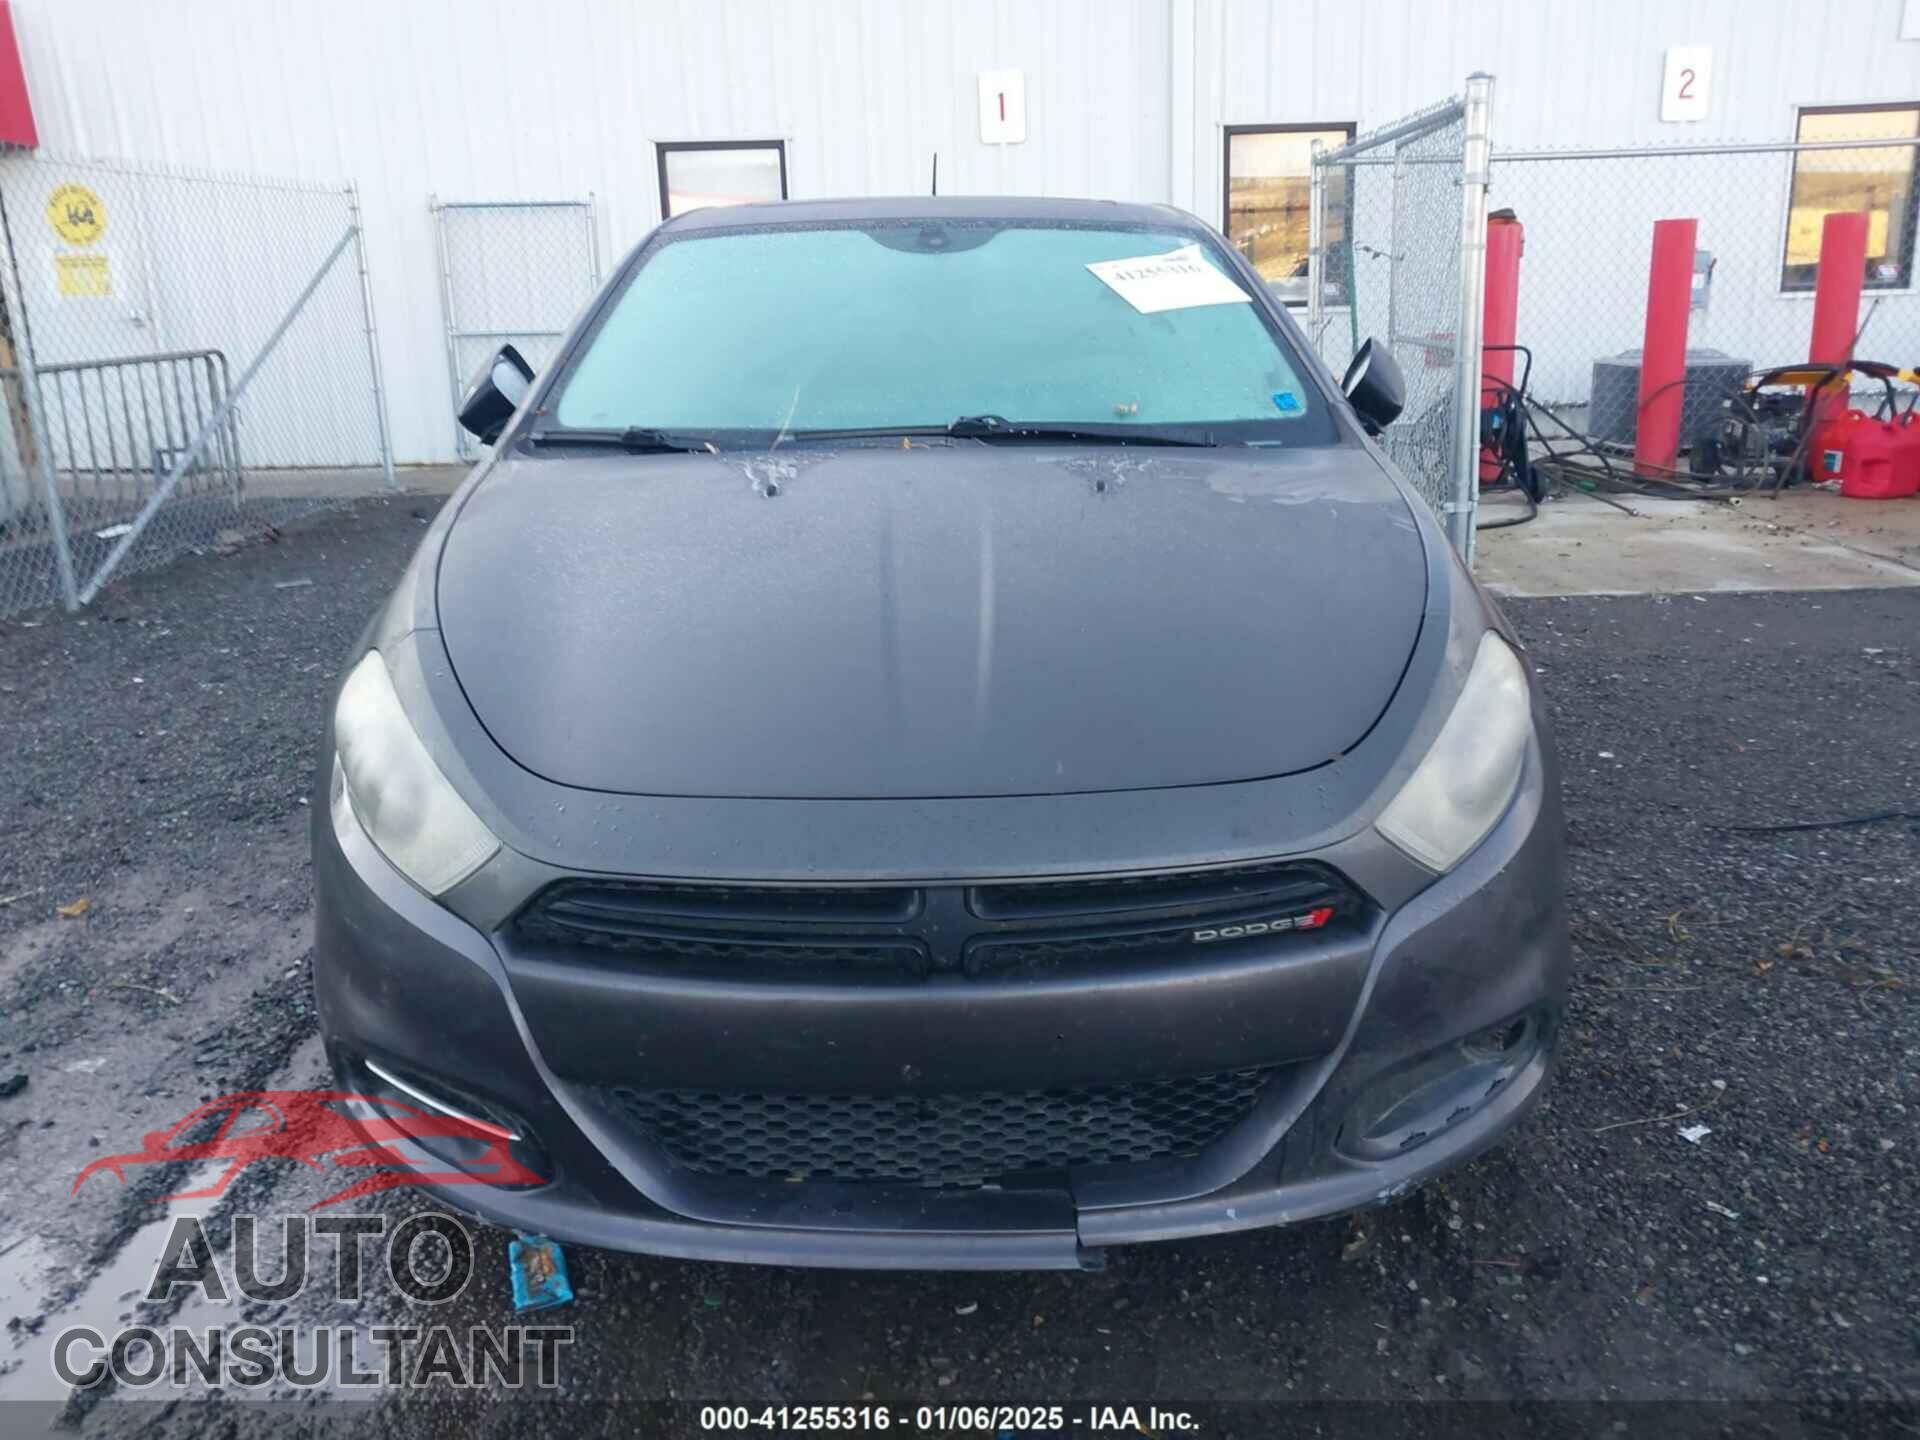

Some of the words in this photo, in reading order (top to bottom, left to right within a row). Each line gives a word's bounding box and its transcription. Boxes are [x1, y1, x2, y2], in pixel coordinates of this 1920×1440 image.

[1679, 68, 1696, 100] 2
[998, 92, 1005, 122] 1
[1193, 914, 1317, 943] DODGE
